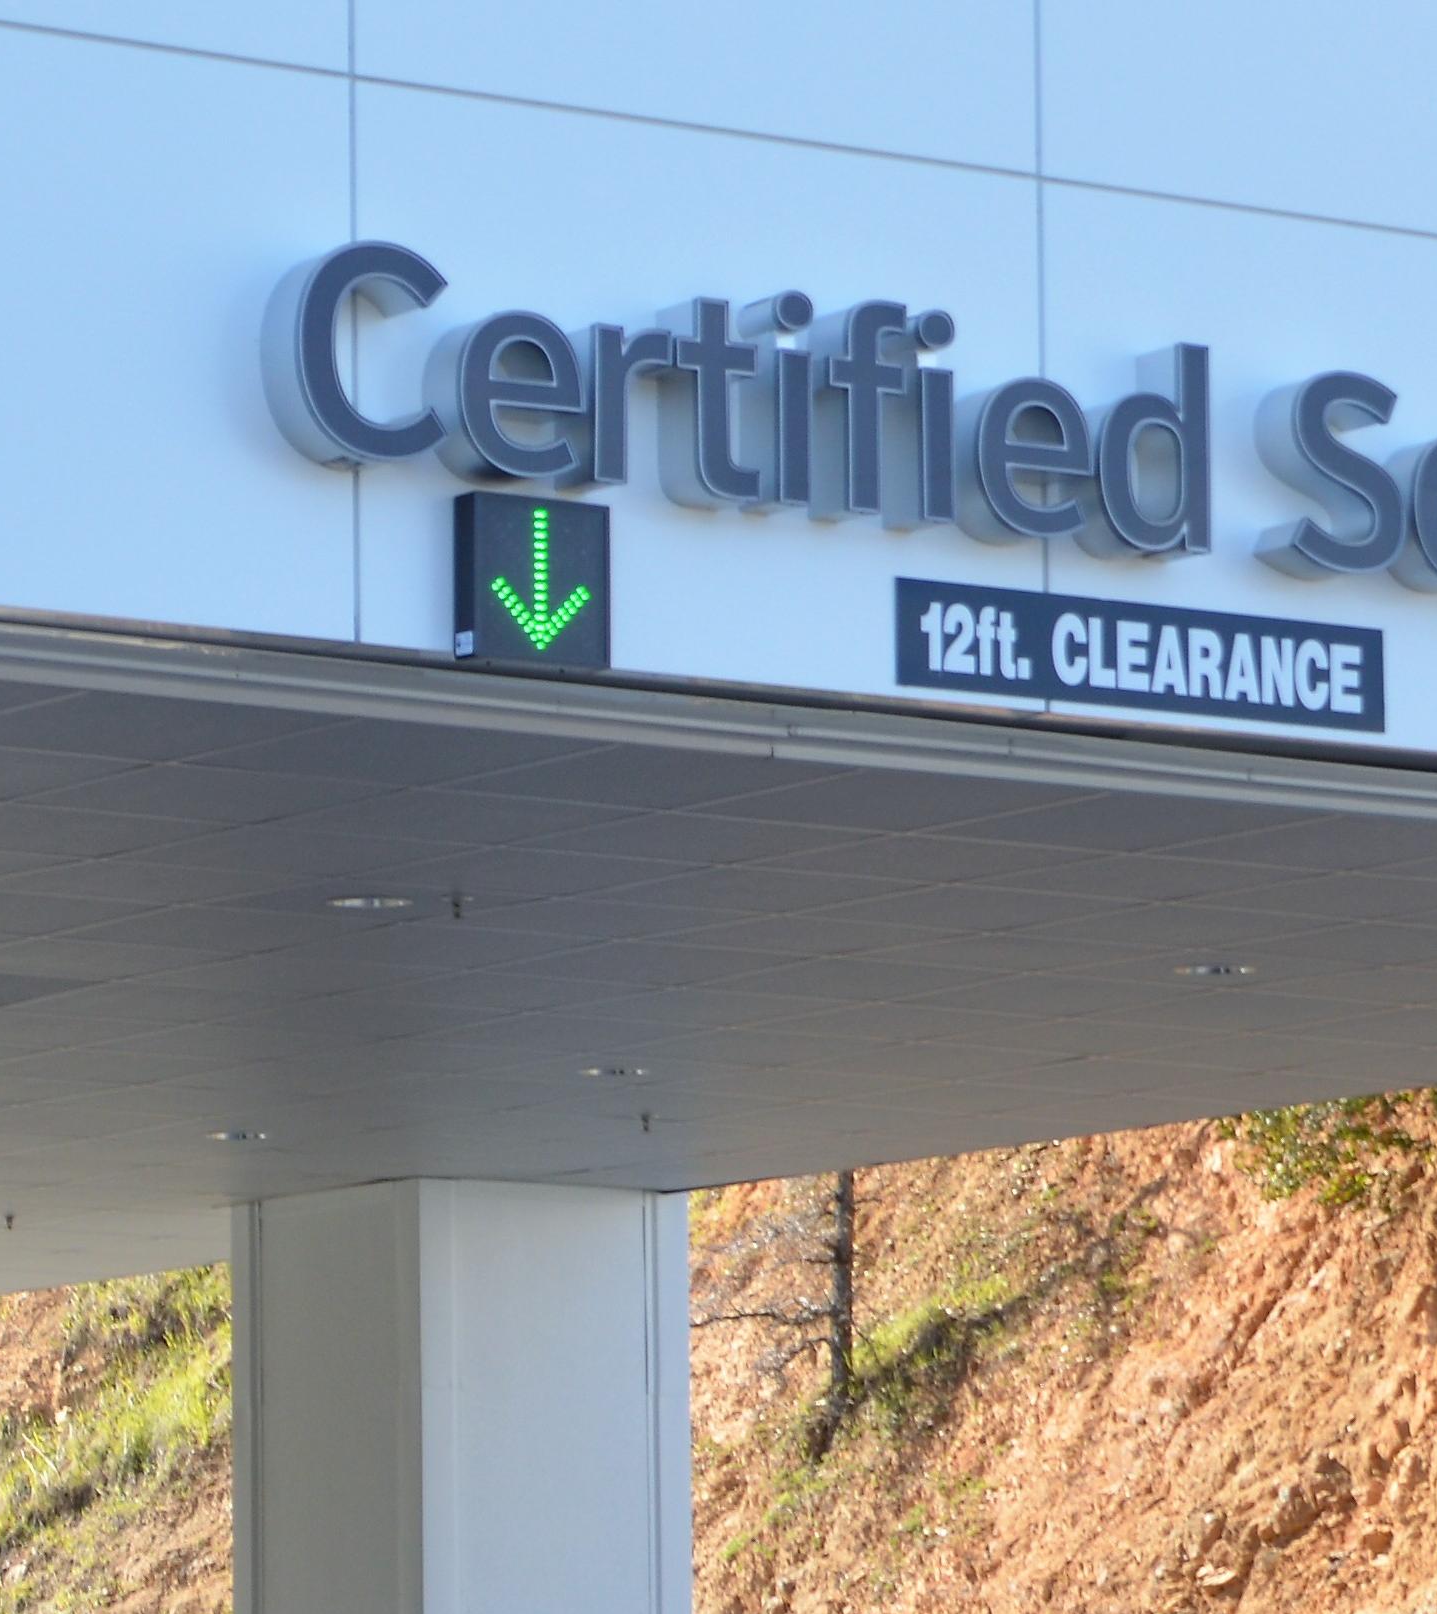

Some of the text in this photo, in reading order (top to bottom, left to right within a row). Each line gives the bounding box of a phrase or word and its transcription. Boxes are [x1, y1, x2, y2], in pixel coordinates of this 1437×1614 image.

[264, 240, 1211, 556] Certified
[920, 600, 1363, 714] 12ft. CLEARANCE
